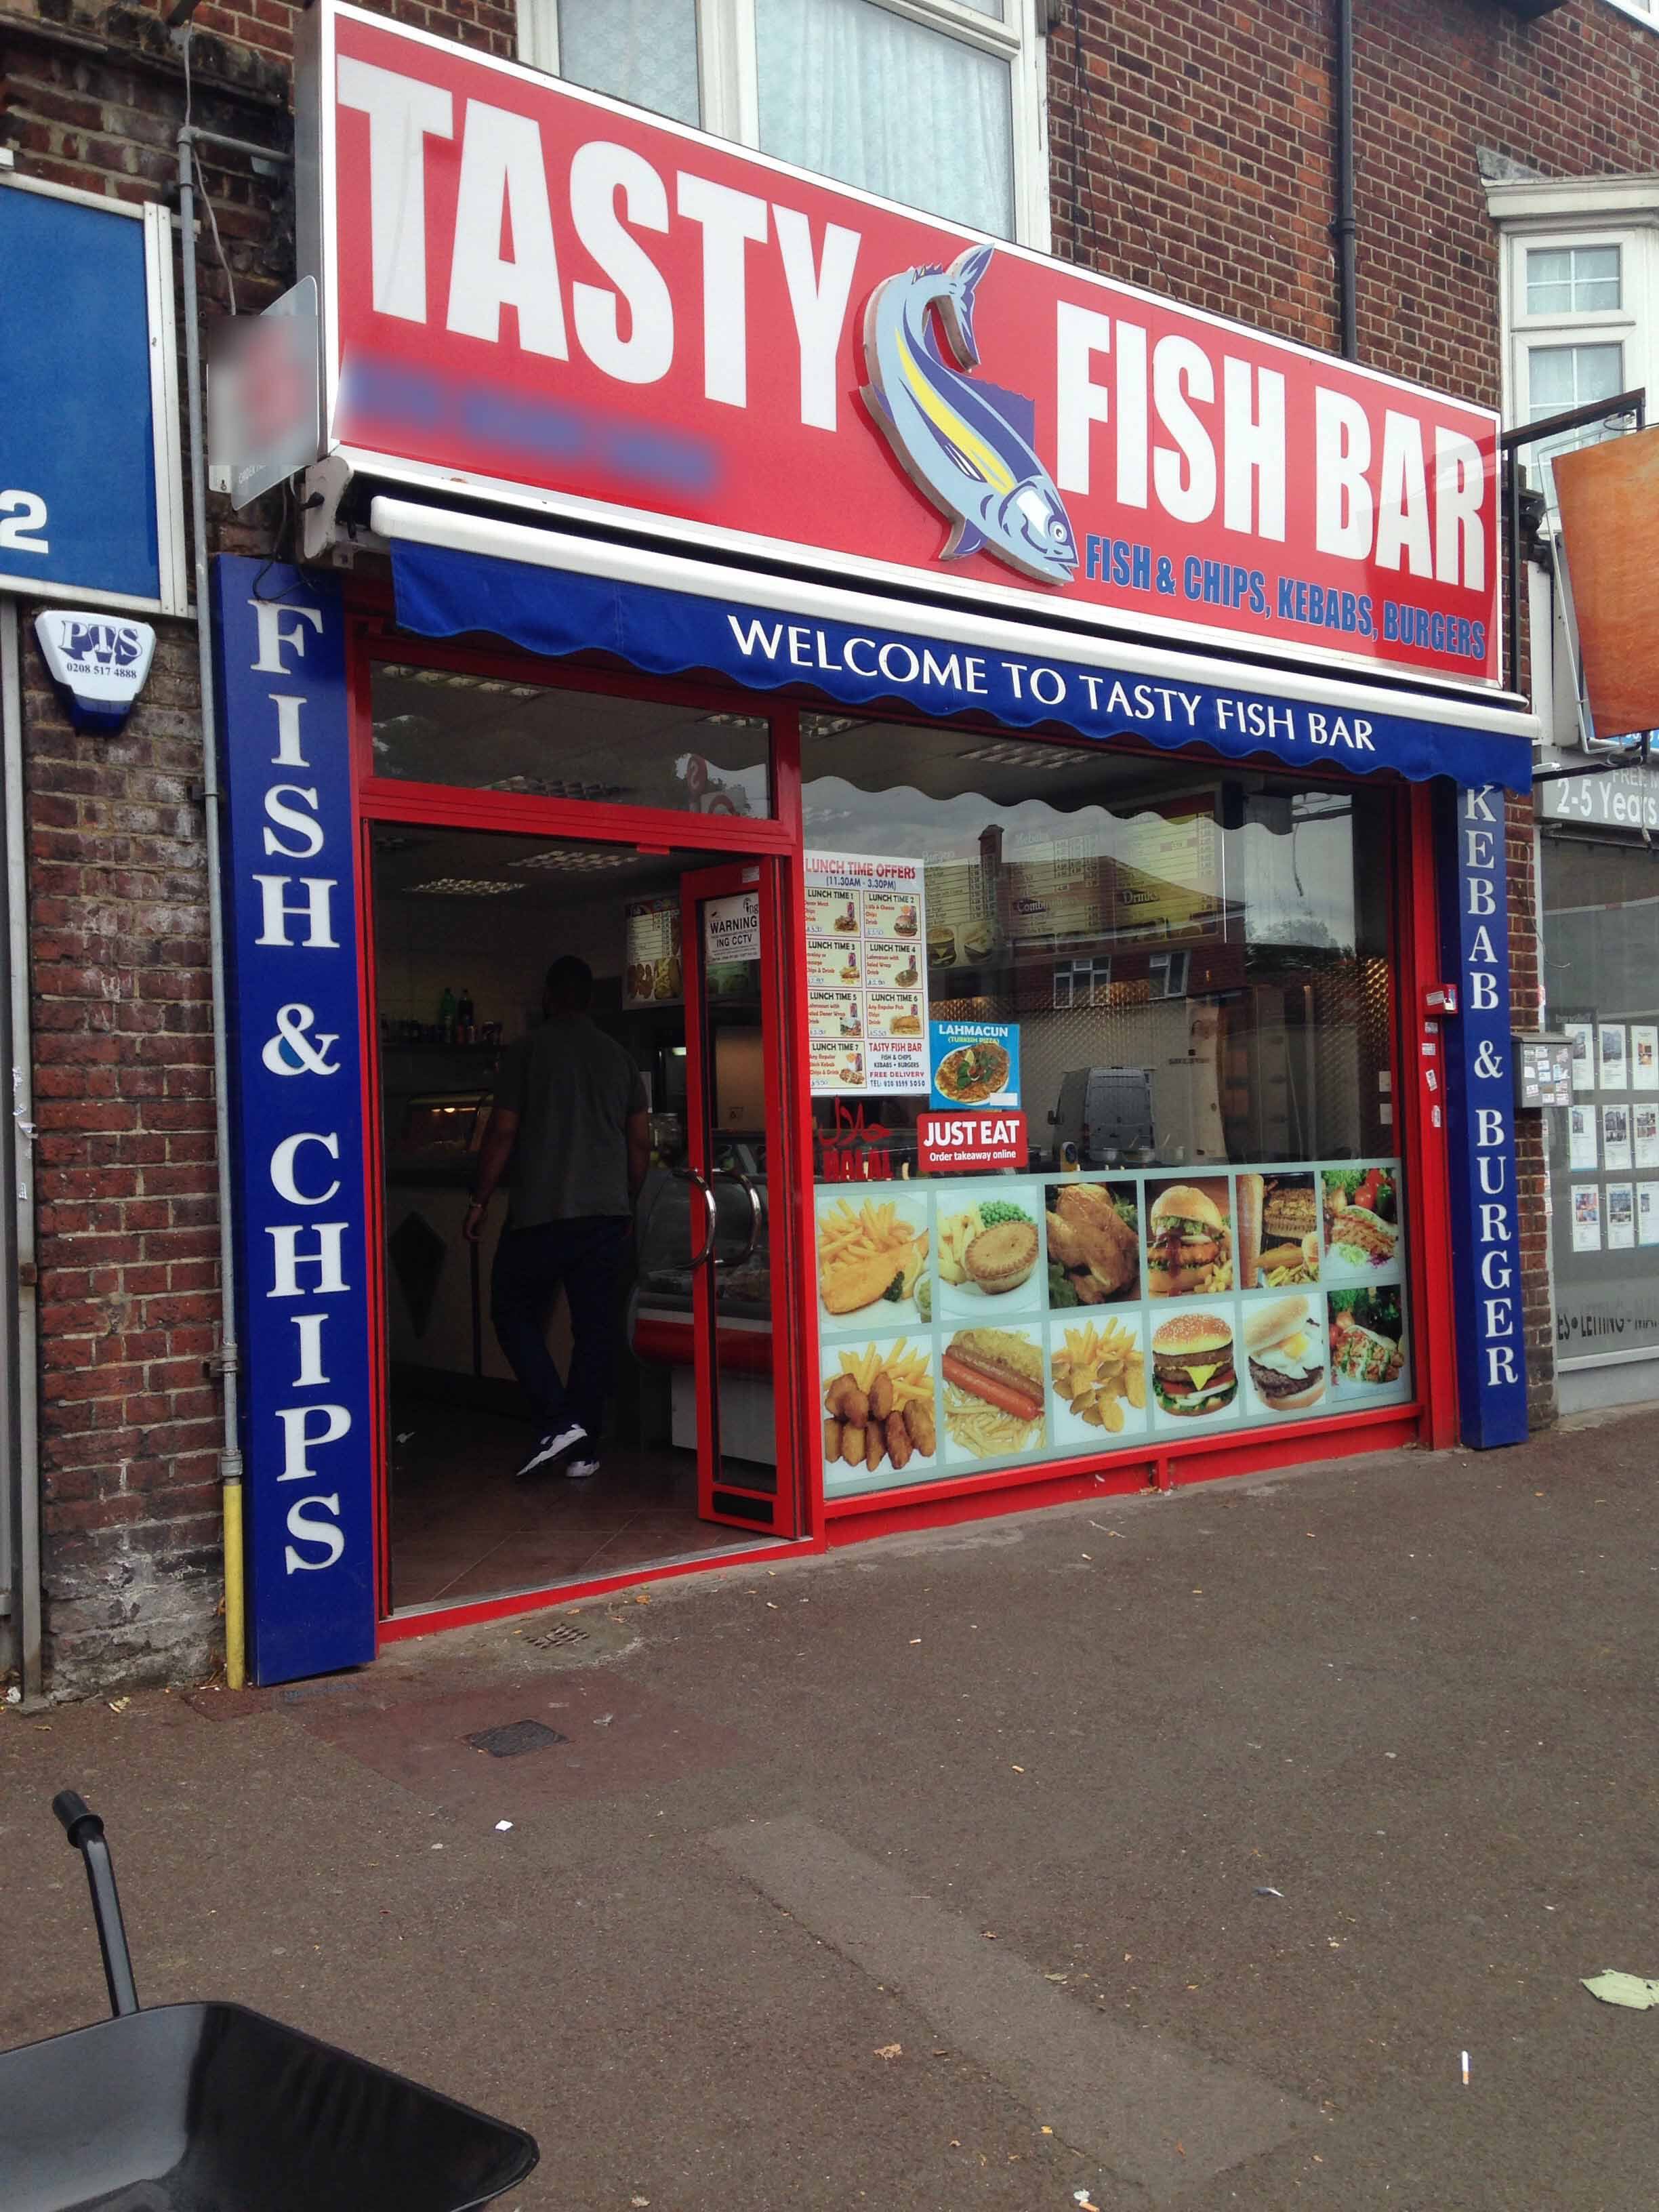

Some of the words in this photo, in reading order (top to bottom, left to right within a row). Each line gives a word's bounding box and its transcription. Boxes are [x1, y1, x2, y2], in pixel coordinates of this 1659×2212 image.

[337, 54, 862, 433] TASTY
[1057, 300, 1286, 543] FISH
[1315, 385, 1485, 592] BAR
[1086, 533, 1151, 592] FISH
[1155, 555, 1176, 595] &
[1183, 555, 1271, 619] CHIPS,
[1277, 577, 1378, 642] KEBABS,
[1383, 600, 1486, 660] BURGERS
[58, 620, 143, 665] PTS
[67, 663, 90, 674] 0208
[94, 666, 110, 676] 517
[114, 668, 137, 678] 4888
[727, 615, 988, 695] WELCOME
[1002, 661, 1067, 705] TO
[1079, 674, 1202, 726] TASTY
[1215, 698, 1295, 739] FISH
[1308, 712, 1376, 752] BAR
[247, 599, 340, 949] FISH
[1557, 778, 1592, 817] 2-5
[1599, 781, 1658, 825] Years
[805, 858, 844, 875] LUNCH
[847, 861, 874, 876] TIME
[876, 863, 916, 880] OFFERS
[808, 889, 832, 898] LUNCH
[834, 891, 849, 899] TIME
[869, 894, 892, 902] LUNCH
[893, 895, 909, 903] TIME
[1464, 785, 1499, 1011] KEBAB
[710, 916, 758, 934] WARNING
[732, 933, 752, 945] CCTV
[808, 941, 833, 949] LUNCH
[895, 945, 910, 953] TIME
[810, 992, 835, 1000] LUNCH
[836, 993, 852, 1001] TIME
[872, 994, 895, 1002] LUNCH
[262, 1003, 342, 1076] &
[939, 1024, 1008, 1037] LAHMACUN
[813, 1043, 836, 1051] LUNCH
[838, 1043, 854, 1051] TIME
[869, 1042, 890, 1052] TASTY
[890, 1042, 907, 1052] FISH
[908, 1042, 922, 1052] BAR
[1474, 1040, 1504, 1080] &
[924, 1121, 977, 1147] JUST
[981, 1120, 1020, 1145] EAT
[929, 1151, 952, 1162] Order
[954, 1150, 991, 1162] takeaway
[993, 1149, 1017, 1159] online
[1476, 1109, 1519, 1388] BURGER
[264, 1132, 352, 1575] CHIPS
